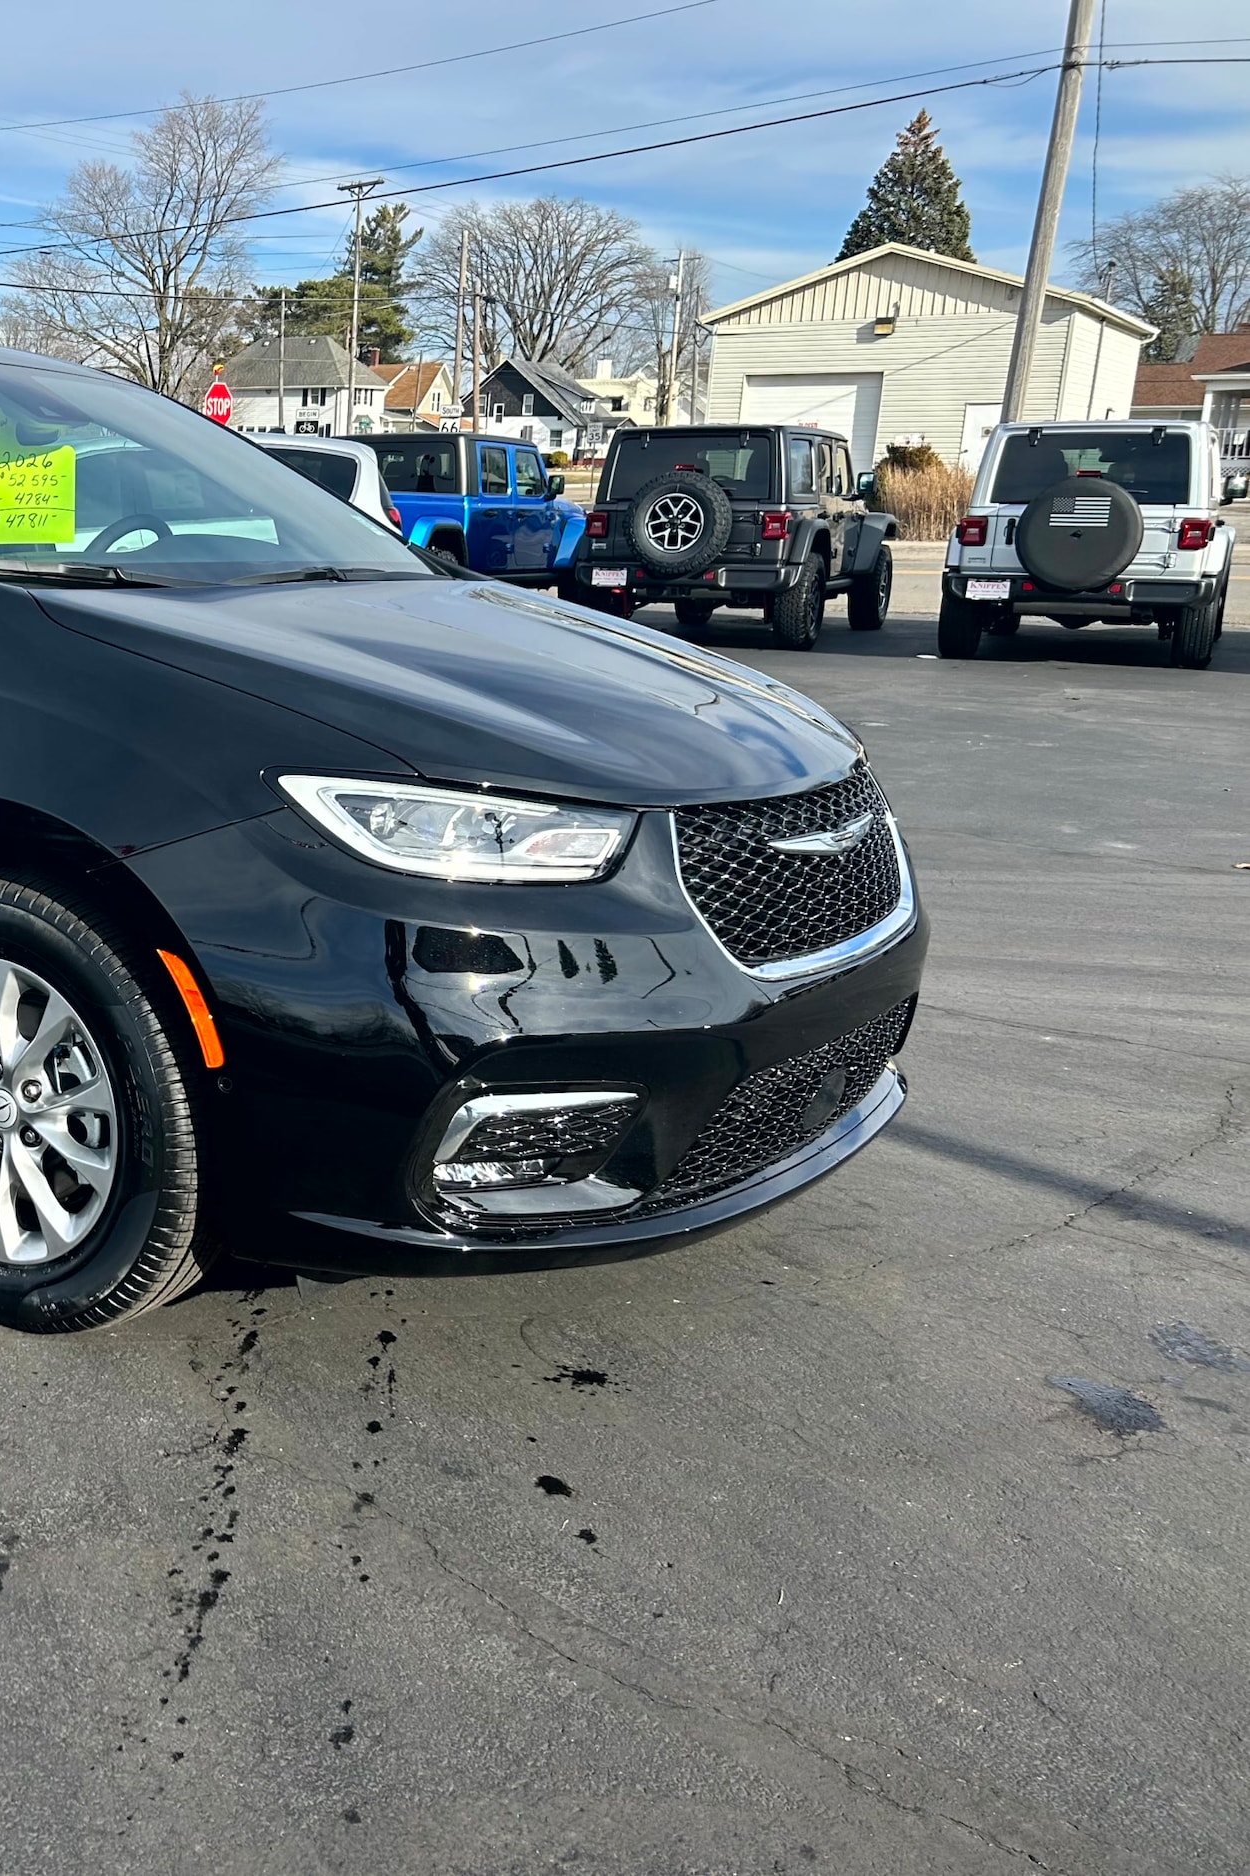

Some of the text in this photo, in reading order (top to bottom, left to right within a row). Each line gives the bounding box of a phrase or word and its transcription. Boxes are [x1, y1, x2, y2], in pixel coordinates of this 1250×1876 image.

[206, 398, 230, 416] STOP
[442, 406, 459, 415] SOUTH
[441, 422, 458, 432] 66
[588, 432, 601, 441] 35
